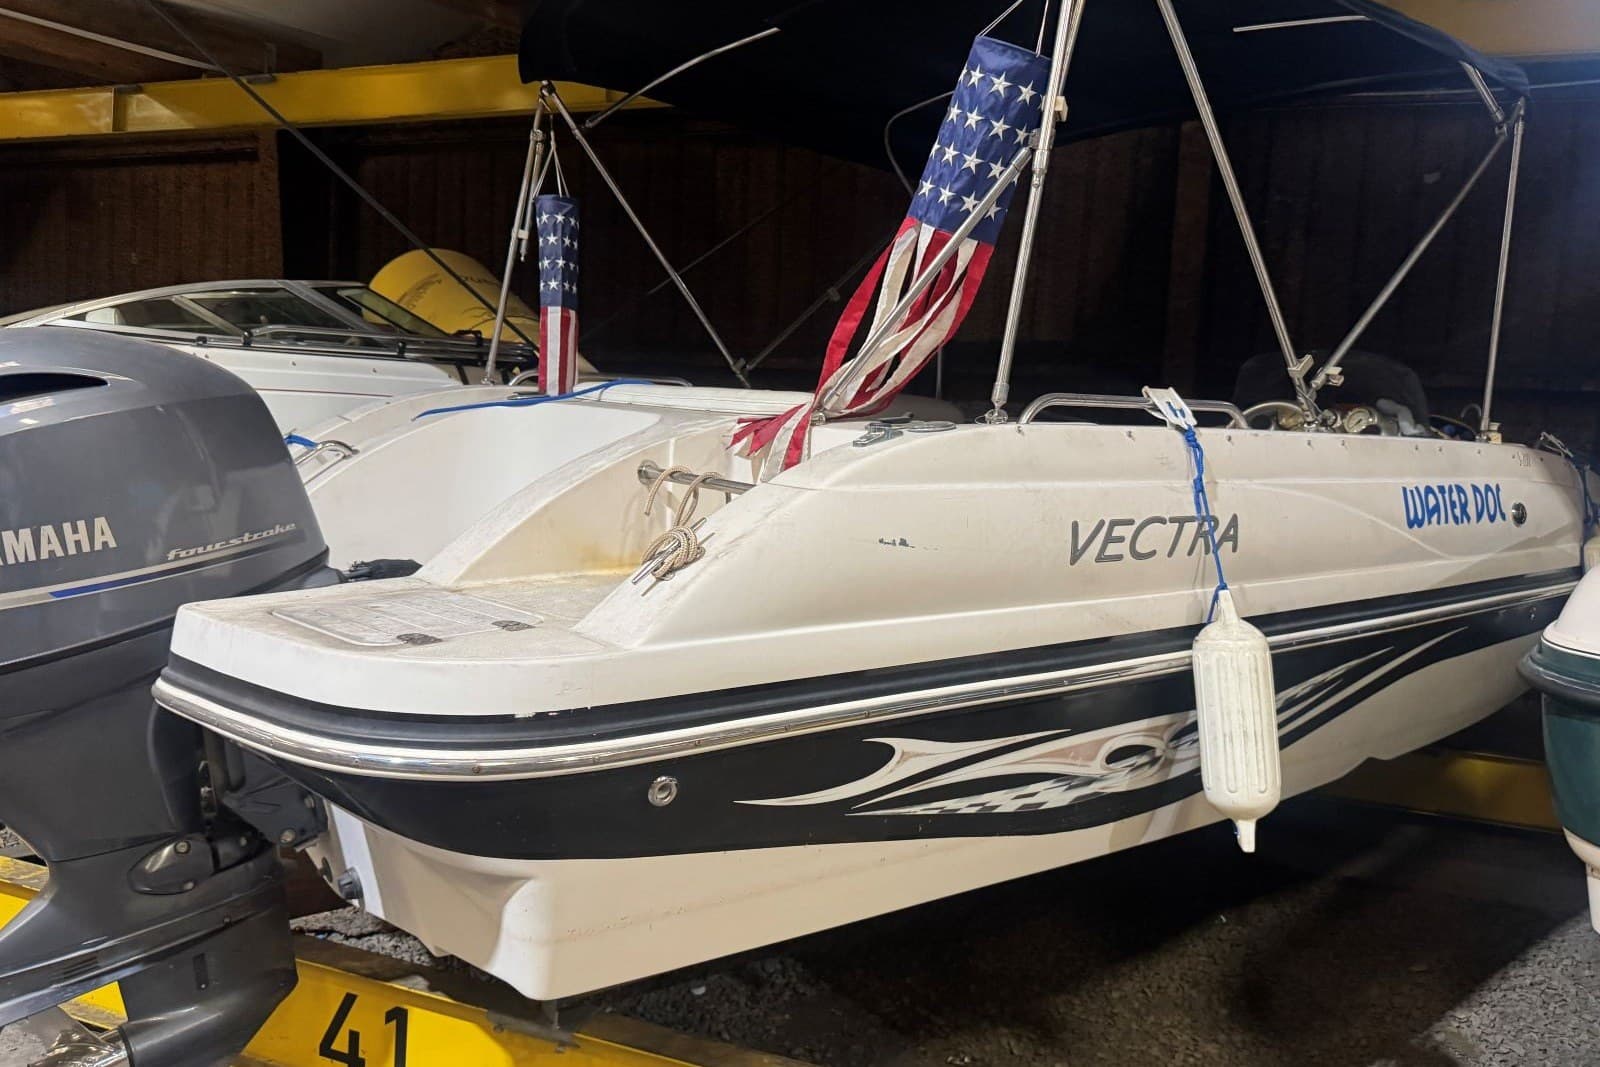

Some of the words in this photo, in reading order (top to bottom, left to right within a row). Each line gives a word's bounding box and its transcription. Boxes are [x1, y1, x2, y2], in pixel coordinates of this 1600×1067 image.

[1401, 483, 1471, 529] WATER
[0, 516, 118, 567] MAHA
[1070, 513, 1239, 566] VECTRA
[319, 992, 408, 1067] 41
